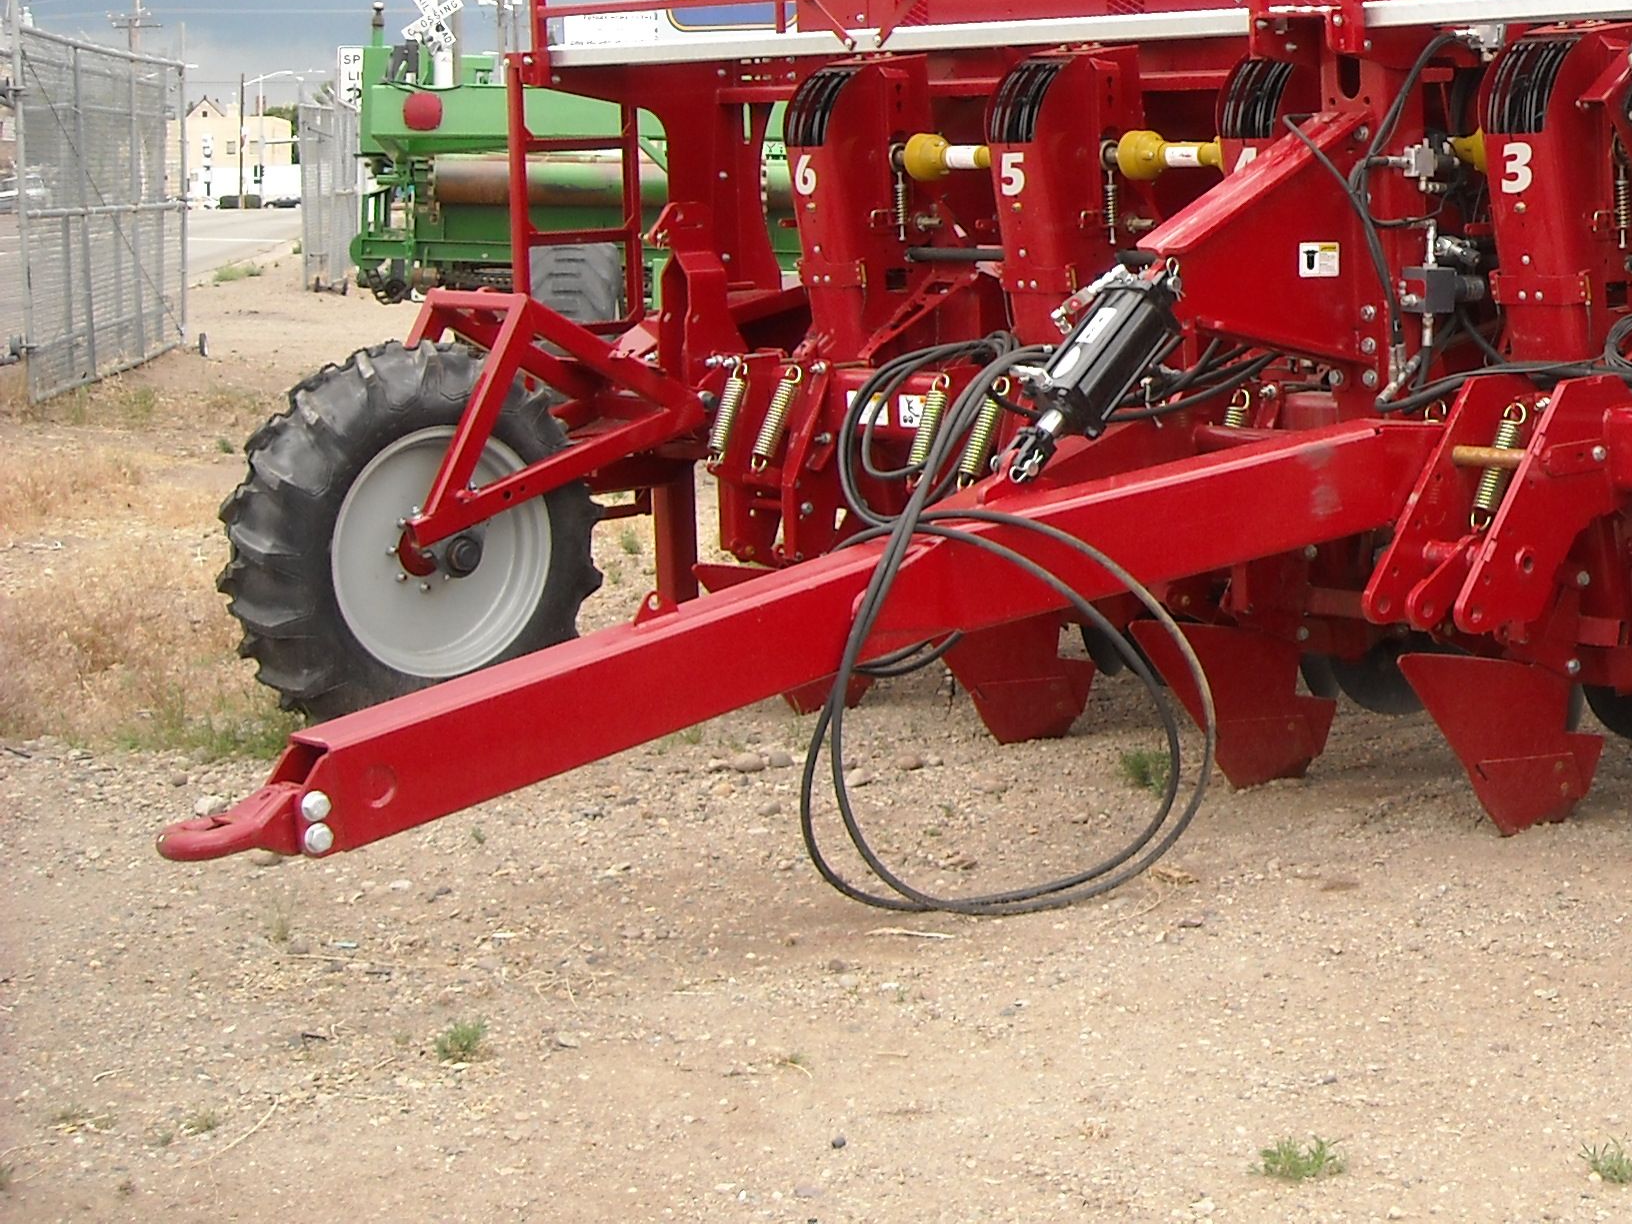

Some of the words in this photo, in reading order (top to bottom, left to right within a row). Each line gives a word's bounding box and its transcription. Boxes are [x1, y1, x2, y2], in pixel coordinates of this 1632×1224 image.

[407, 0, 458, 37] COSSING
[794, 154, 817, 196] 6
[1000, 151, 1025, 197] 5
[1501, 141, 1533, 194] 3
